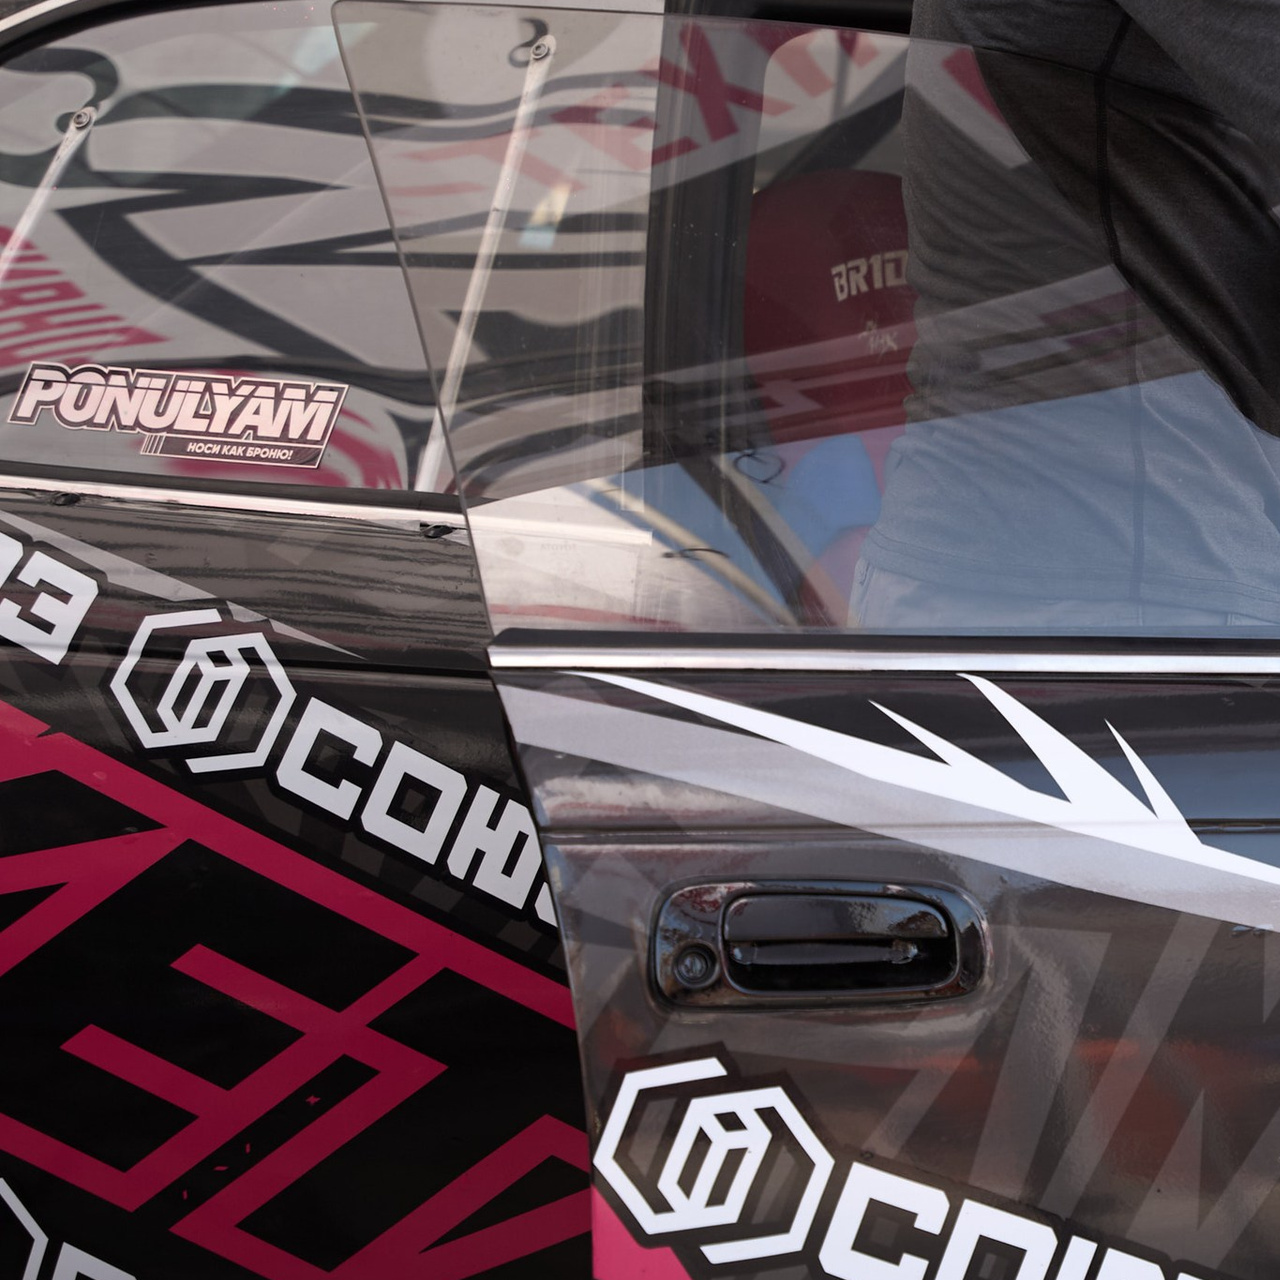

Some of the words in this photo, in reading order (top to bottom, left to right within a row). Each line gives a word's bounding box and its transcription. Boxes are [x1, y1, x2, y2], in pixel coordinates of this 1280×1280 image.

[831, 249, 909, 302] BRID
[14, 366, 342, 442] PONULYAM
[187, 442, 220, 456] НОСИ
[221, 444, 244, 458] КАК
[246, 446, 293, 460] БРОНЮ!
